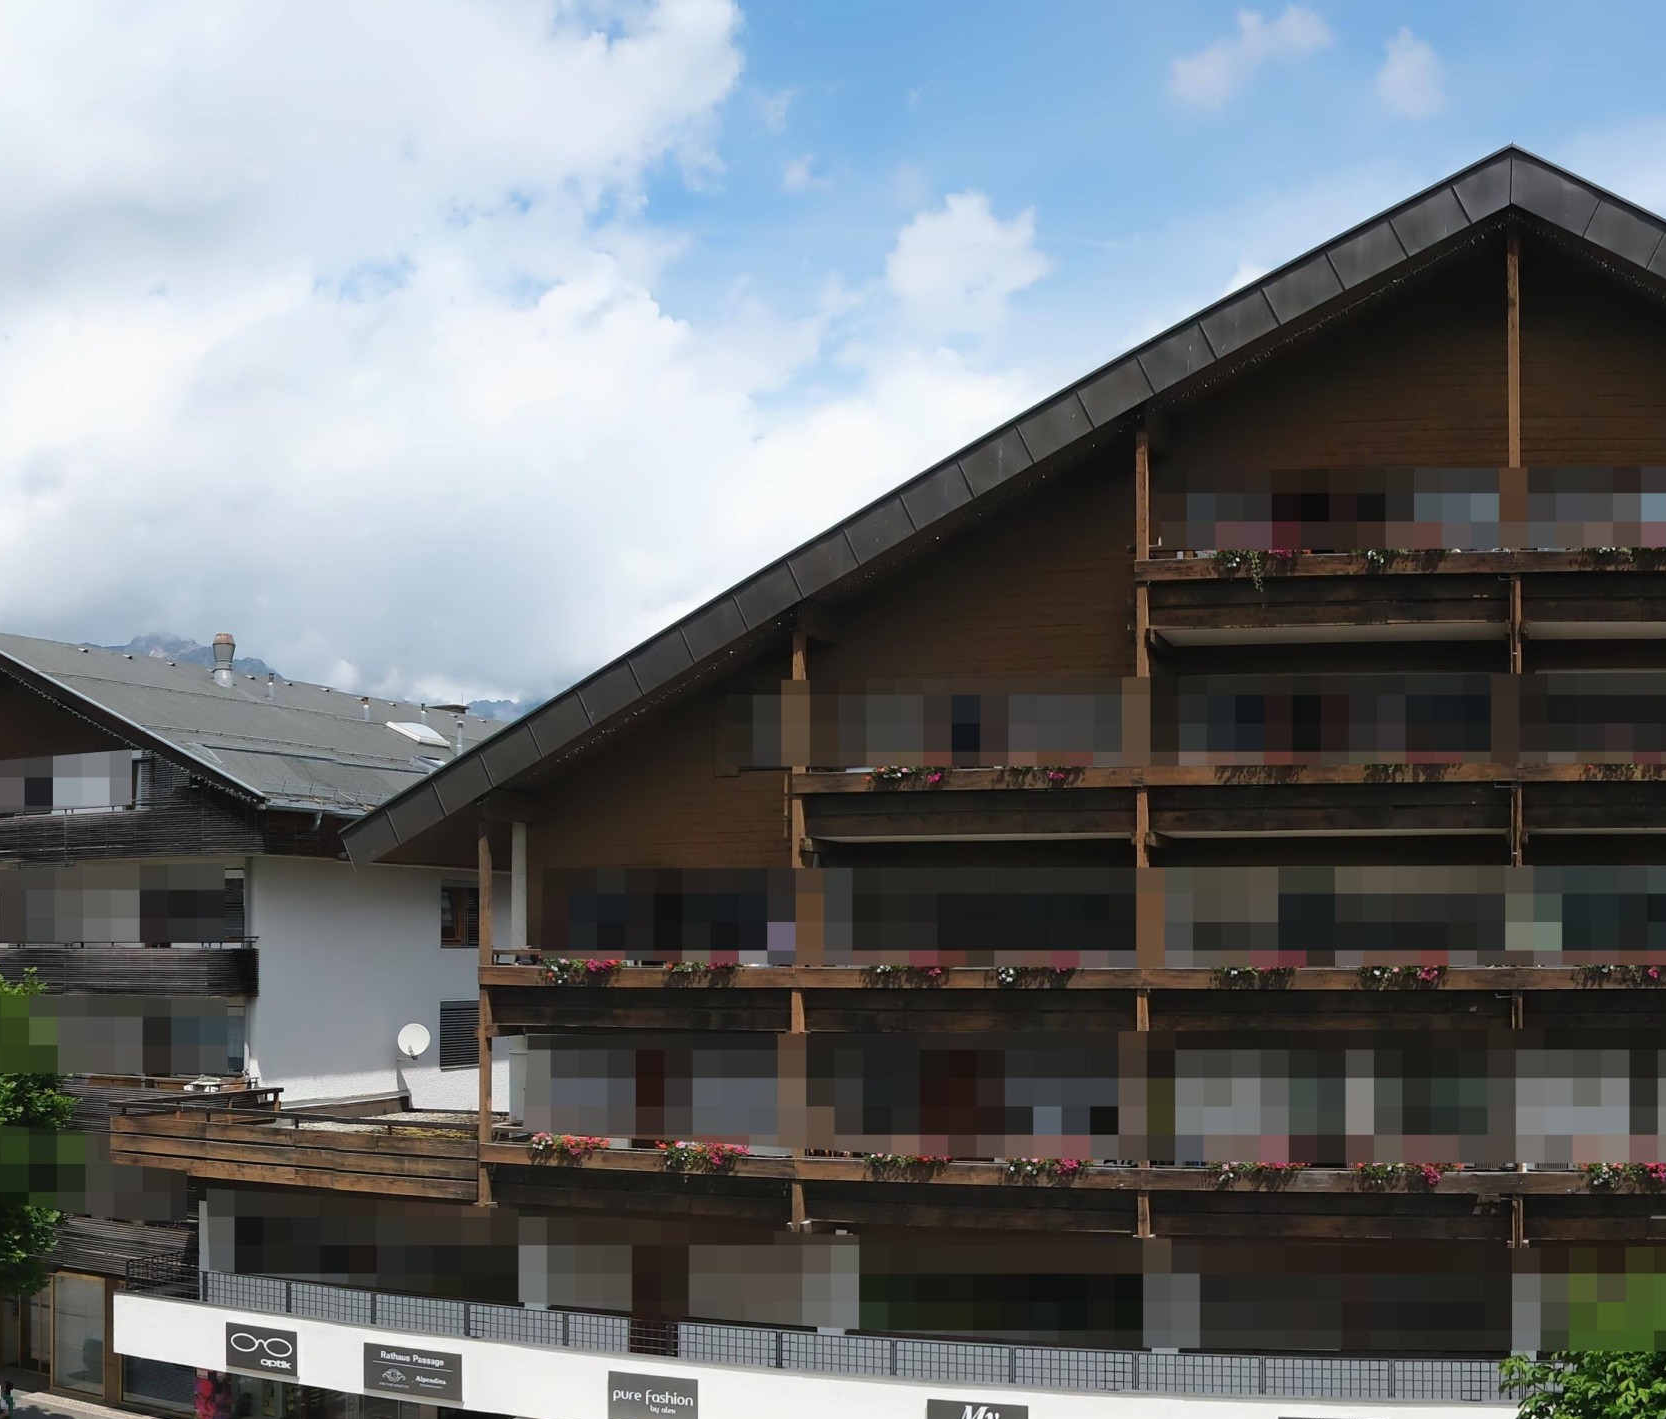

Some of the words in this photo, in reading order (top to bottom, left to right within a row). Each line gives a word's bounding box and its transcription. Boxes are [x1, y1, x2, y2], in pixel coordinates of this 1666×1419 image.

[380, 1350, 411, 1362] Rathaus
[413, 1354, 445, 1367] Passage
[613, 1389, 642, 1402] pure
[645, 1389, 694, 1407] fashion
[650, 1404, 660, 1415] by
